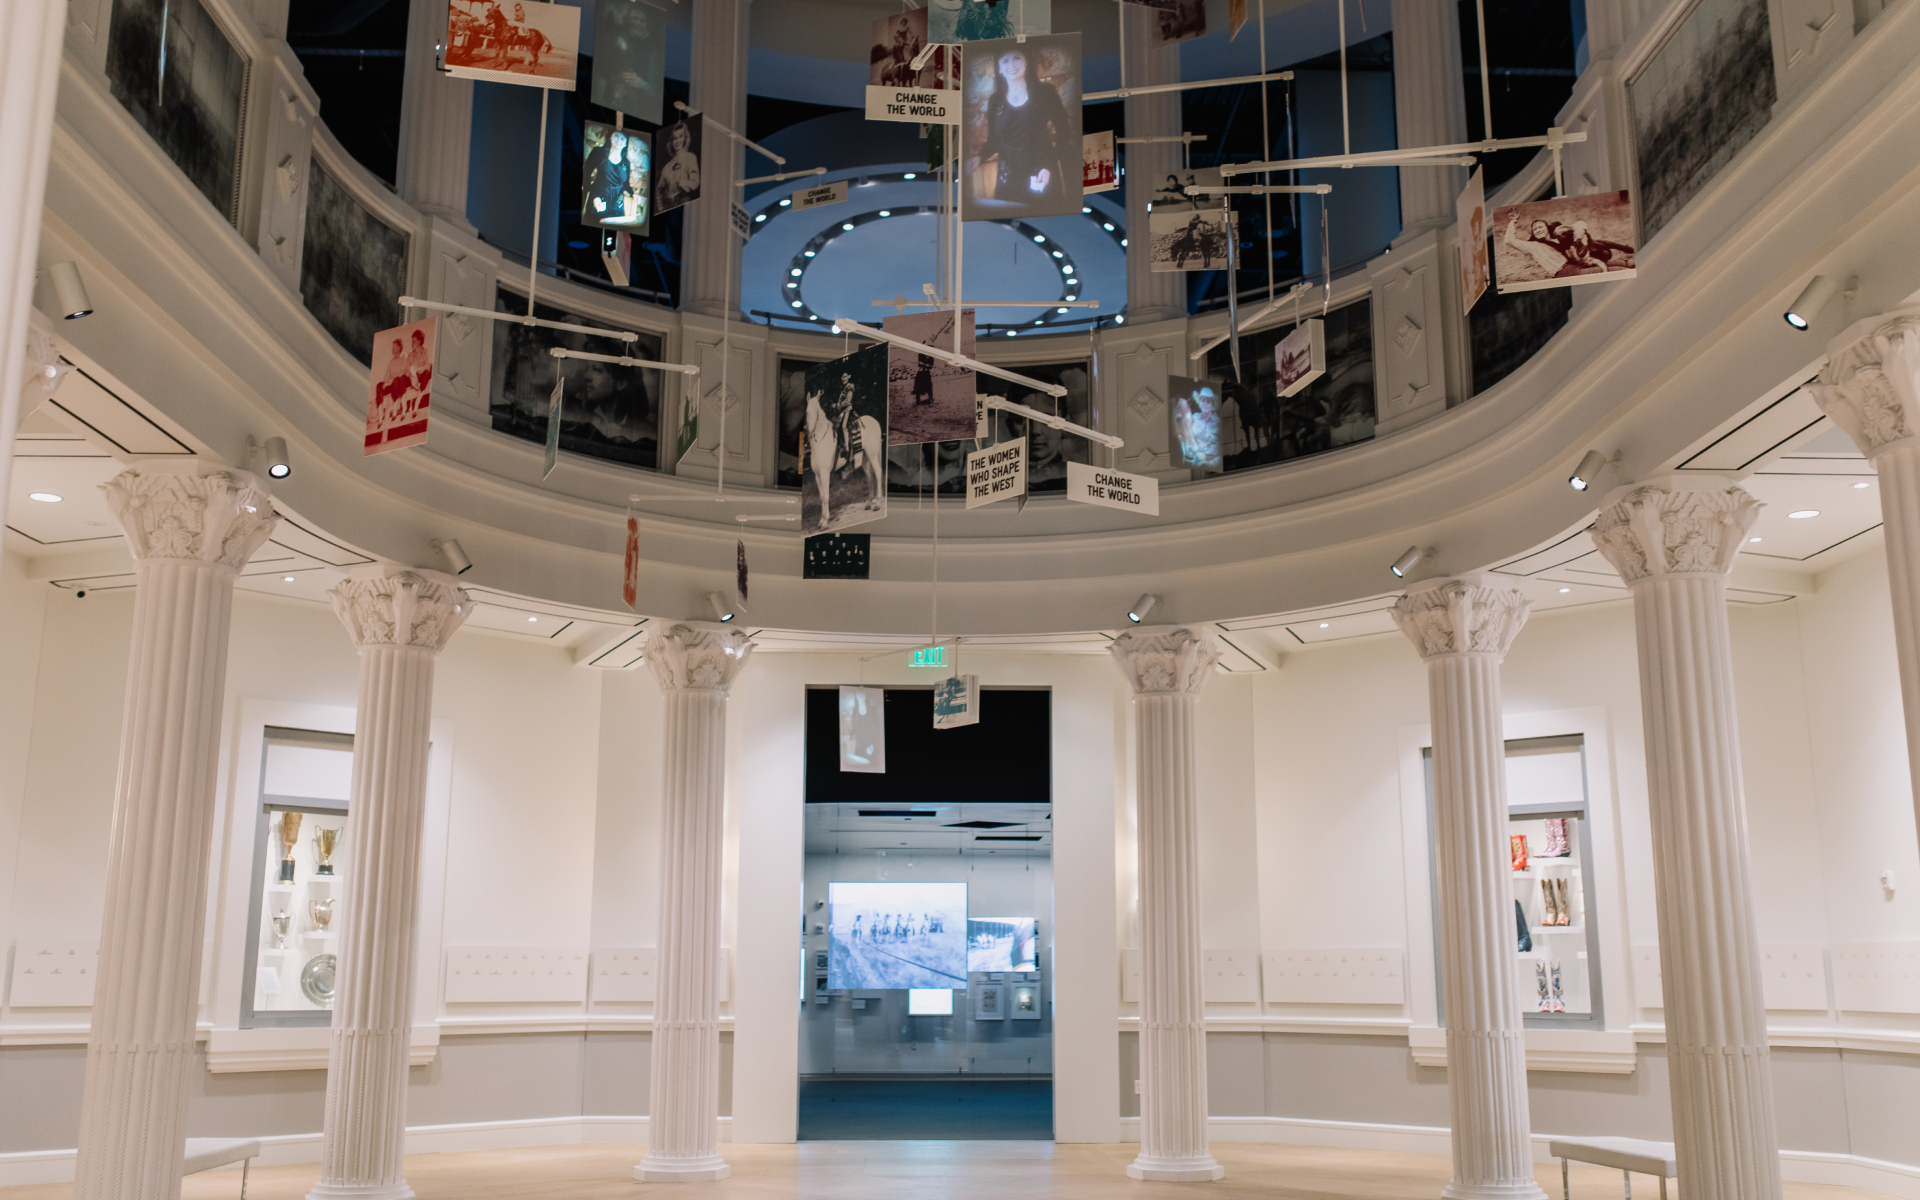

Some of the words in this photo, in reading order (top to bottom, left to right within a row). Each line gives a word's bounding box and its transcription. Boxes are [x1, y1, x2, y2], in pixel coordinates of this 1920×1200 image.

[895, 93, 938, 104] CHANGE
[886, 104, 906, 114] THE
[909, 105, 946, 116] WORLD
[970, 457, 986, 471] THE
[988, 446, 1020, 466] WOMEN
[970, 470, 990, 485] WHO
[992, 461, 1020, 479] SHAPE
[1095, 473, 1132, 490] CHANGE
[974, 483, 990, 498] THE
[992, 476, 1016, 494] WEST
[1087, 485, 1105, 498] THE
[1107, 488, 1140, 504] WORLD
[915, 646, 944, 664] EXIT
